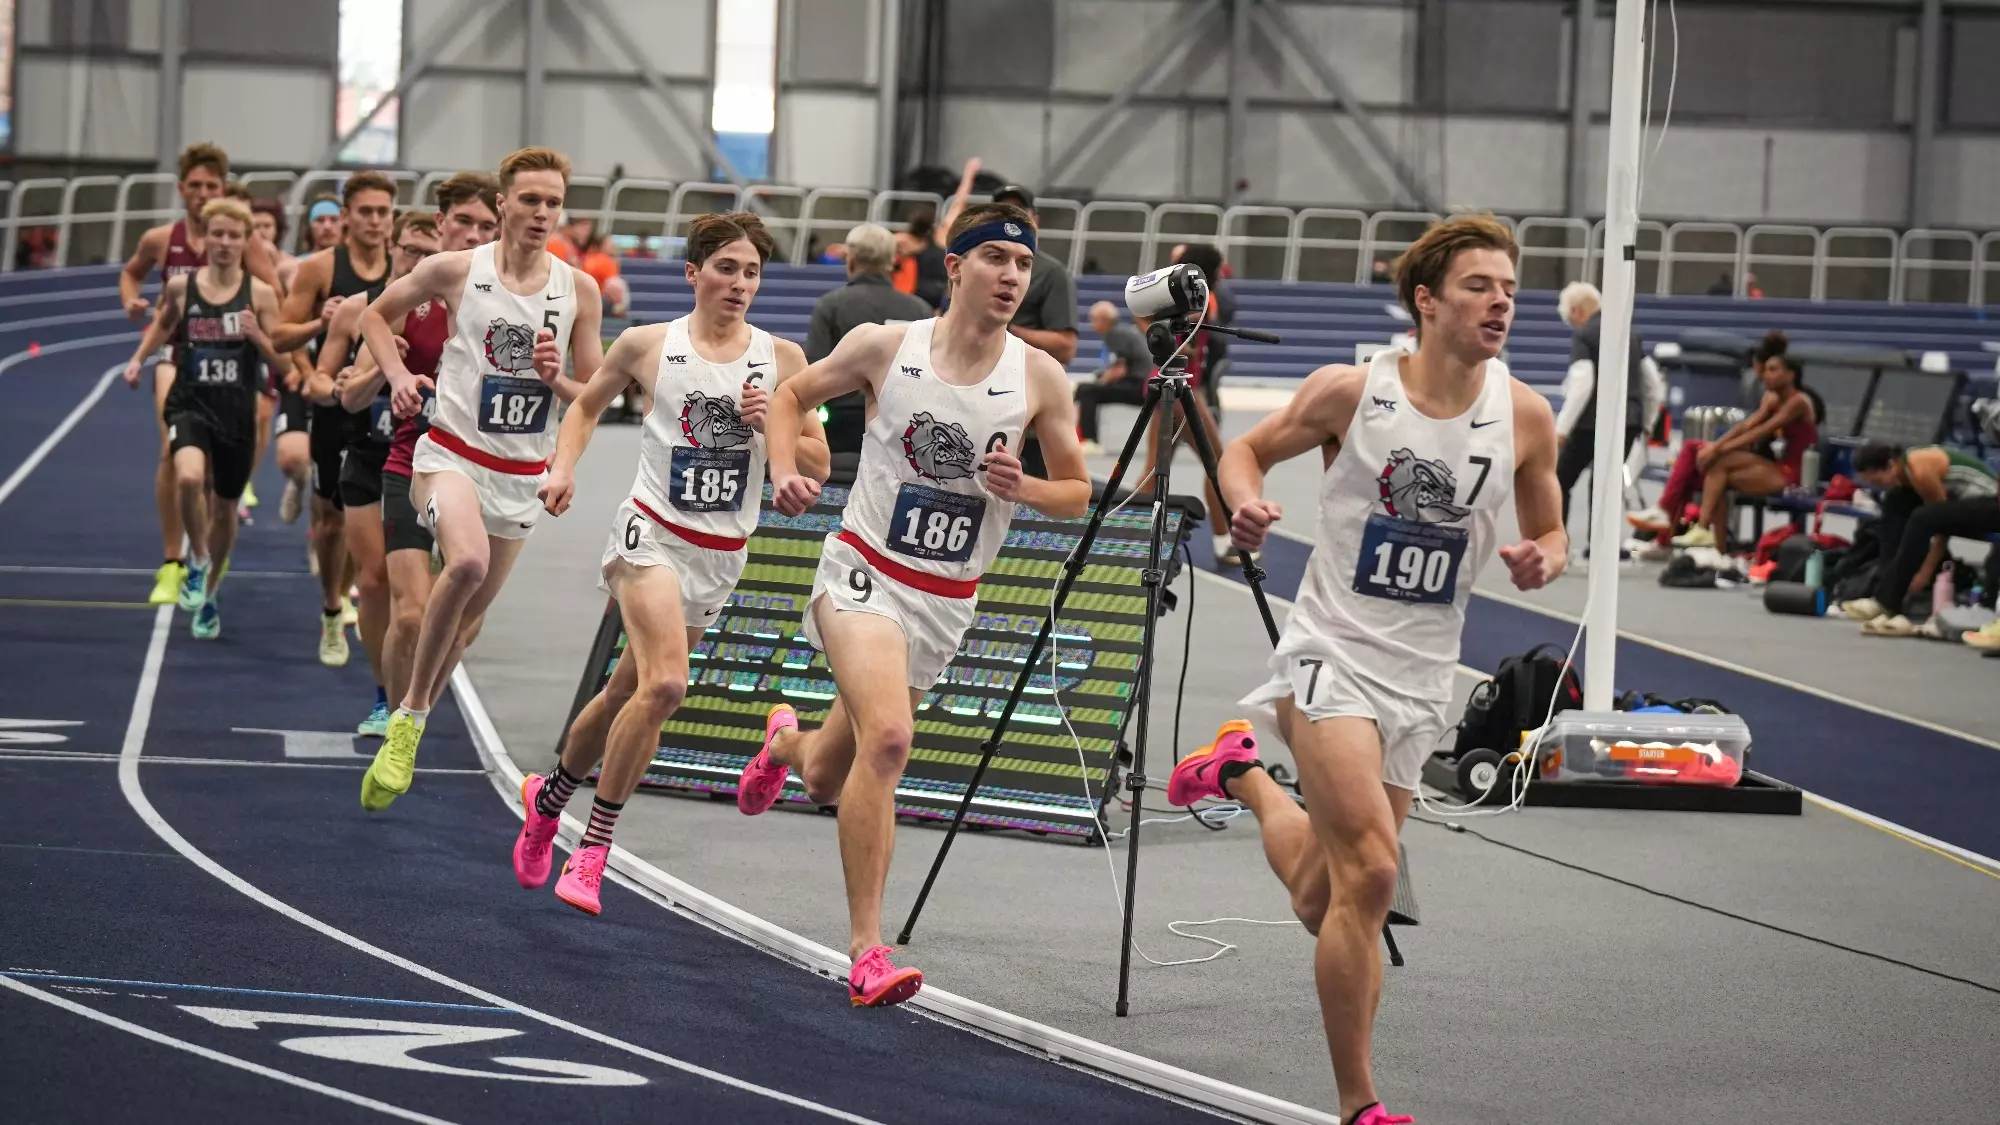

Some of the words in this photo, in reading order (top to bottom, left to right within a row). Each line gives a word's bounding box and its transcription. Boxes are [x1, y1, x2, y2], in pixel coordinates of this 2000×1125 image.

[474, 283, 493, 292] WCC
[198, 359, 239, 383] 138
[666, 355, 687, 363] WCC
[901, 365, 923, 377] WCC
[488, 394, 544, 426] 187
[1372, 395, 1397, 410] WCC
[680, 467, 740, 503] 185
[1465, 455, 1492, 506] 7
[625, 513, 645, 550] 6
[900, 507, 972, 552] 186
[1369, 541, 1450, 593] 190
[849, 568, 872, 603] 9
[1300, 658, 1323, 706] 7
